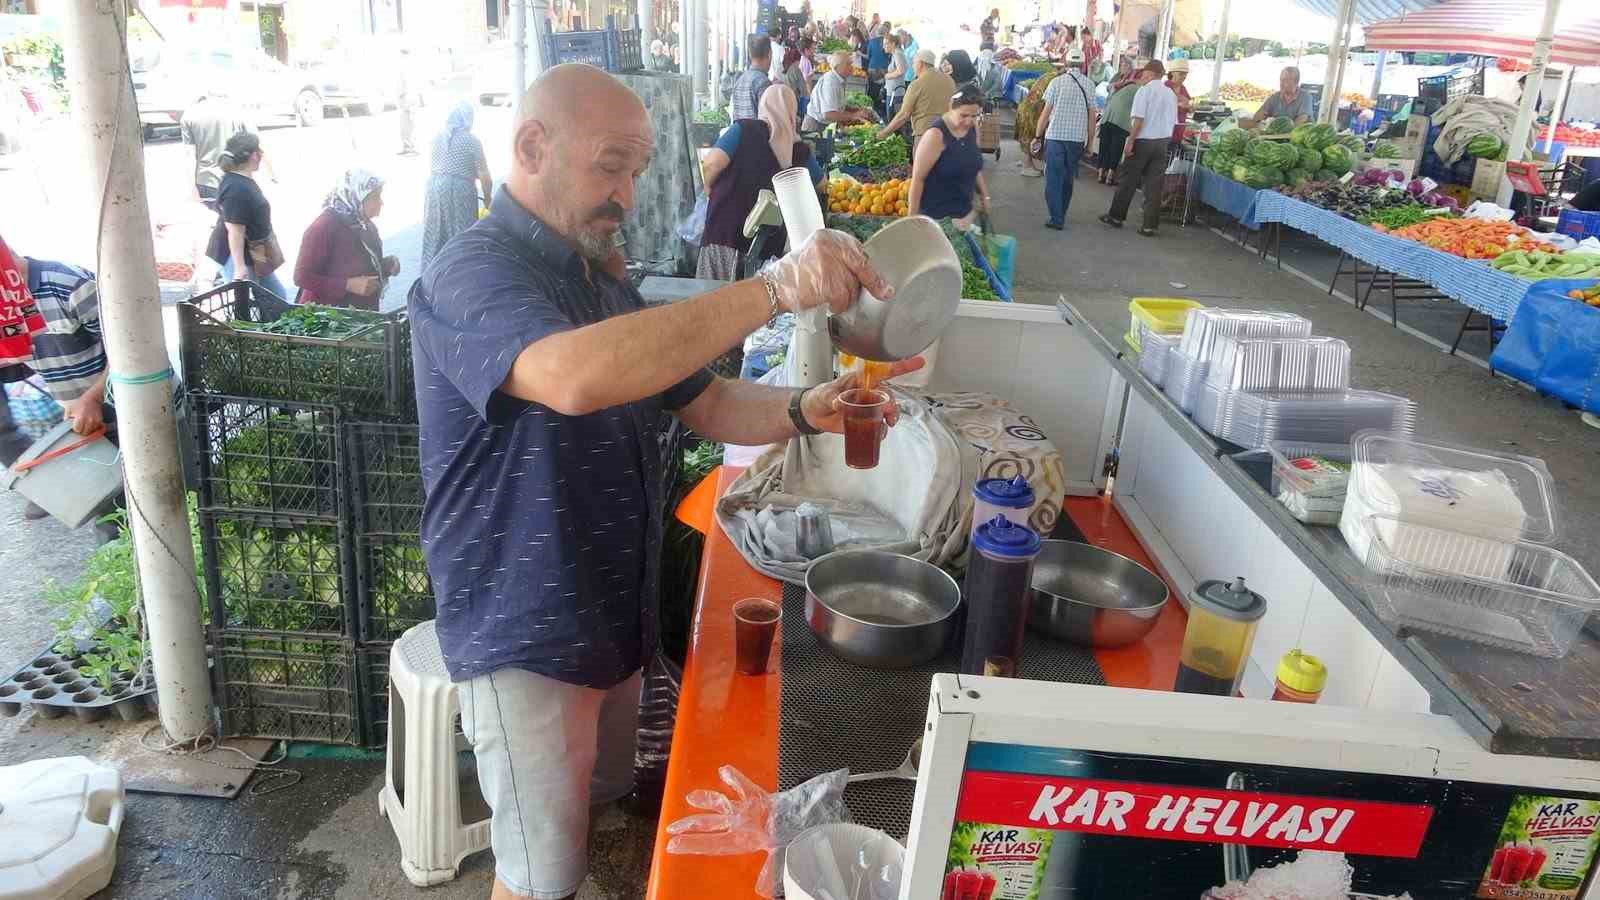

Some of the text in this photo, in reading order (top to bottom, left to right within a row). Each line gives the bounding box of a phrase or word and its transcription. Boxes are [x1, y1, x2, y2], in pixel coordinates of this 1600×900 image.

[1028, 784, 1355, 844] KAR HELVASI
[1538, 803, 1579, 817] KAR
[980, 830, 1018, 843] KAR
